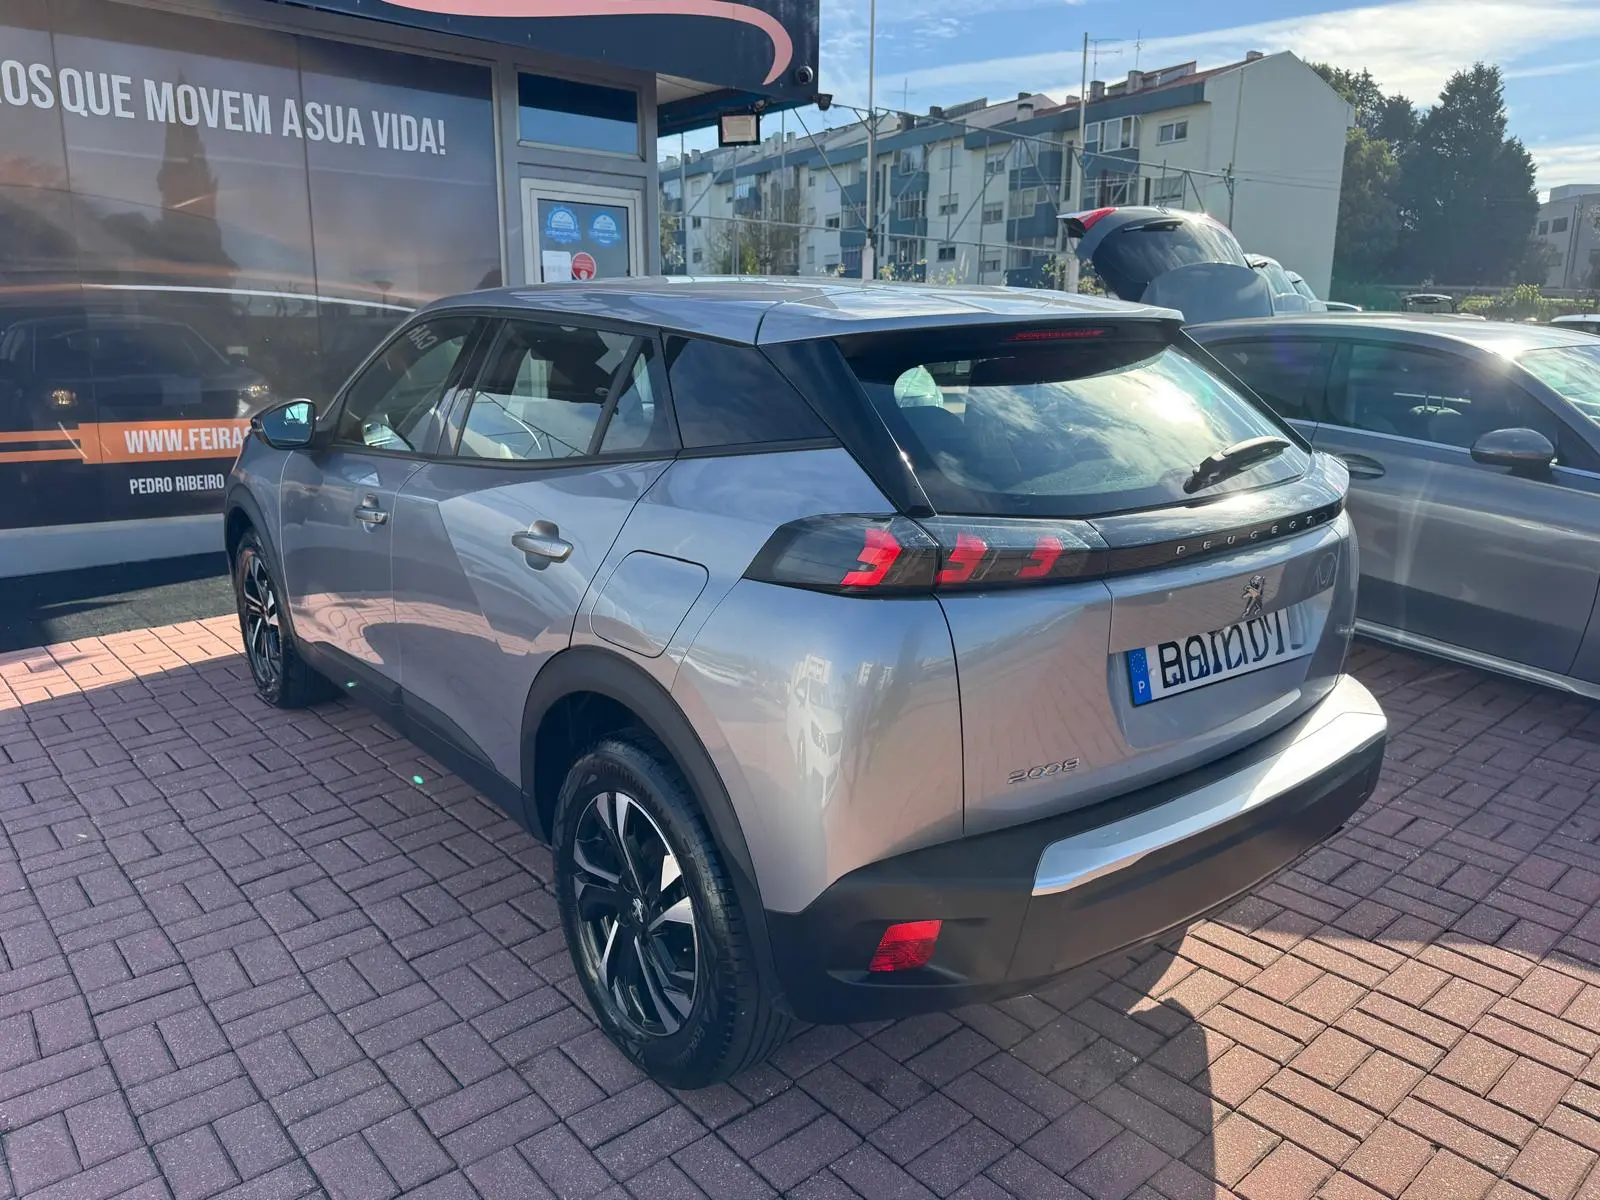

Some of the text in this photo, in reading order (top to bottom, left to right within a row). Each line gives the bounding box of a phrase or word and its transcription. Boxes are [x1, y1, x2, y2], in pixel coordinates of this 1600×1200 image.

[0, 59, 447, 155] OS QUE MOVEM A SUA VIDA!
[129, 473, 225, 495] PEDRO RIBEIRO
[1175, 515, 1313, 555] PEUGEOT
[1137, 680, 1146, 694] P
[1007, 757, 1080, 785] 2008
